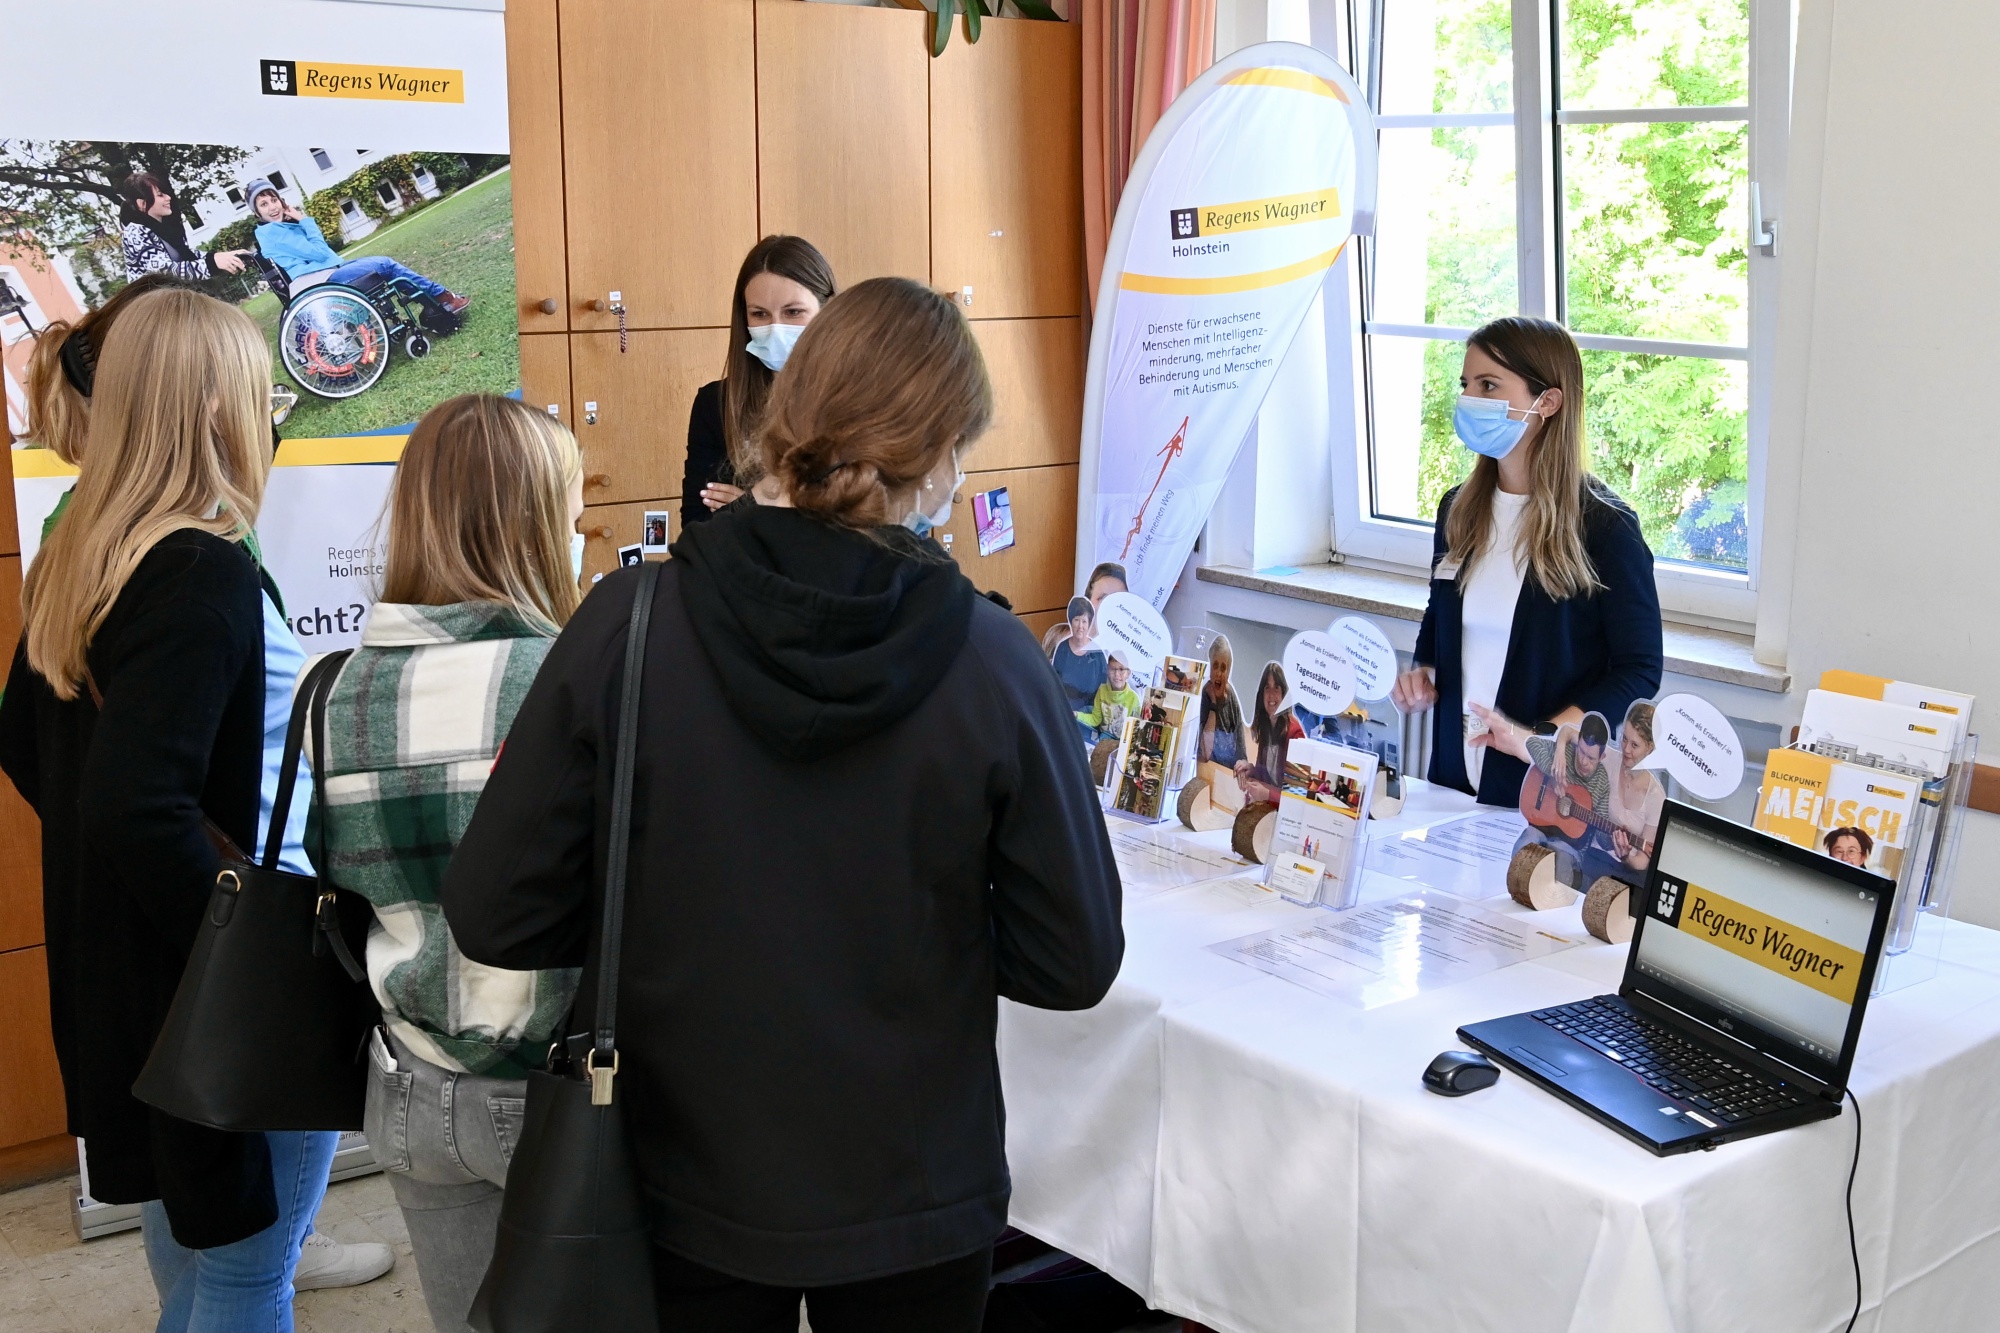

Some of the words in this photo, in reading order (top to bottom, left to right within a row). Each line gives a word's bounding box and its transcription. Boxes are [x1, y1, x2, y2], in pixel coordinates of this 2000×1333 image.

[305, 69, 372, 93] Regens
[378, 72, 450, 97] Wagner
[1205, 209, 1260, 230] Regens
[1264, 199, 1327, 221] Wagner
[1172, 241, 1230, 258] Holnstein
[1148, 321, 1184, 335] Dienste
[1186, 318, 1201, 330] für
[1203, 311, 1261, 328] erwachsene
[1142, 337, 1191, 352] Menschen
[1193, 334, 1210, 346] mit
[1213, 327, 1268, 343] Intelligenz-
[1149, 352, 1204, 368] minderung,
[1206, 343, 1261, 360] mehrfacher
[1139, 369, 1200, 385] Behinderung
[1202, 365, 1221, 377] und
[1224, 357, 1273, 374] Menschen
[1173, 385, 1190, 397] mit
[1191, 380, 1239, 395] Autismus.
[1140, 534, 1154, 555] finde
[1150, 507, 1166, 535] meinen
[1161, 489, 1175, 507] Weg
[328, 547, 377, 563] Regens
[1152, 586, 1165, 606] ein.de
[1106, 619, 1130, 642] Offenen
[1295, 662, 1330, 688] Tagesstätte
[1330, 679, 1341, 692] für
[1370, 660, 1379, 670] für
[1697, 739, 1706, 750] die
[1770, 770, 1822, 789] BLICKPUNKT
[1763, 785, 1903, 843] MENSCH
[1687, 896, 1758, 946] Regens
[1759, 925, 1844, 981] Wagner
